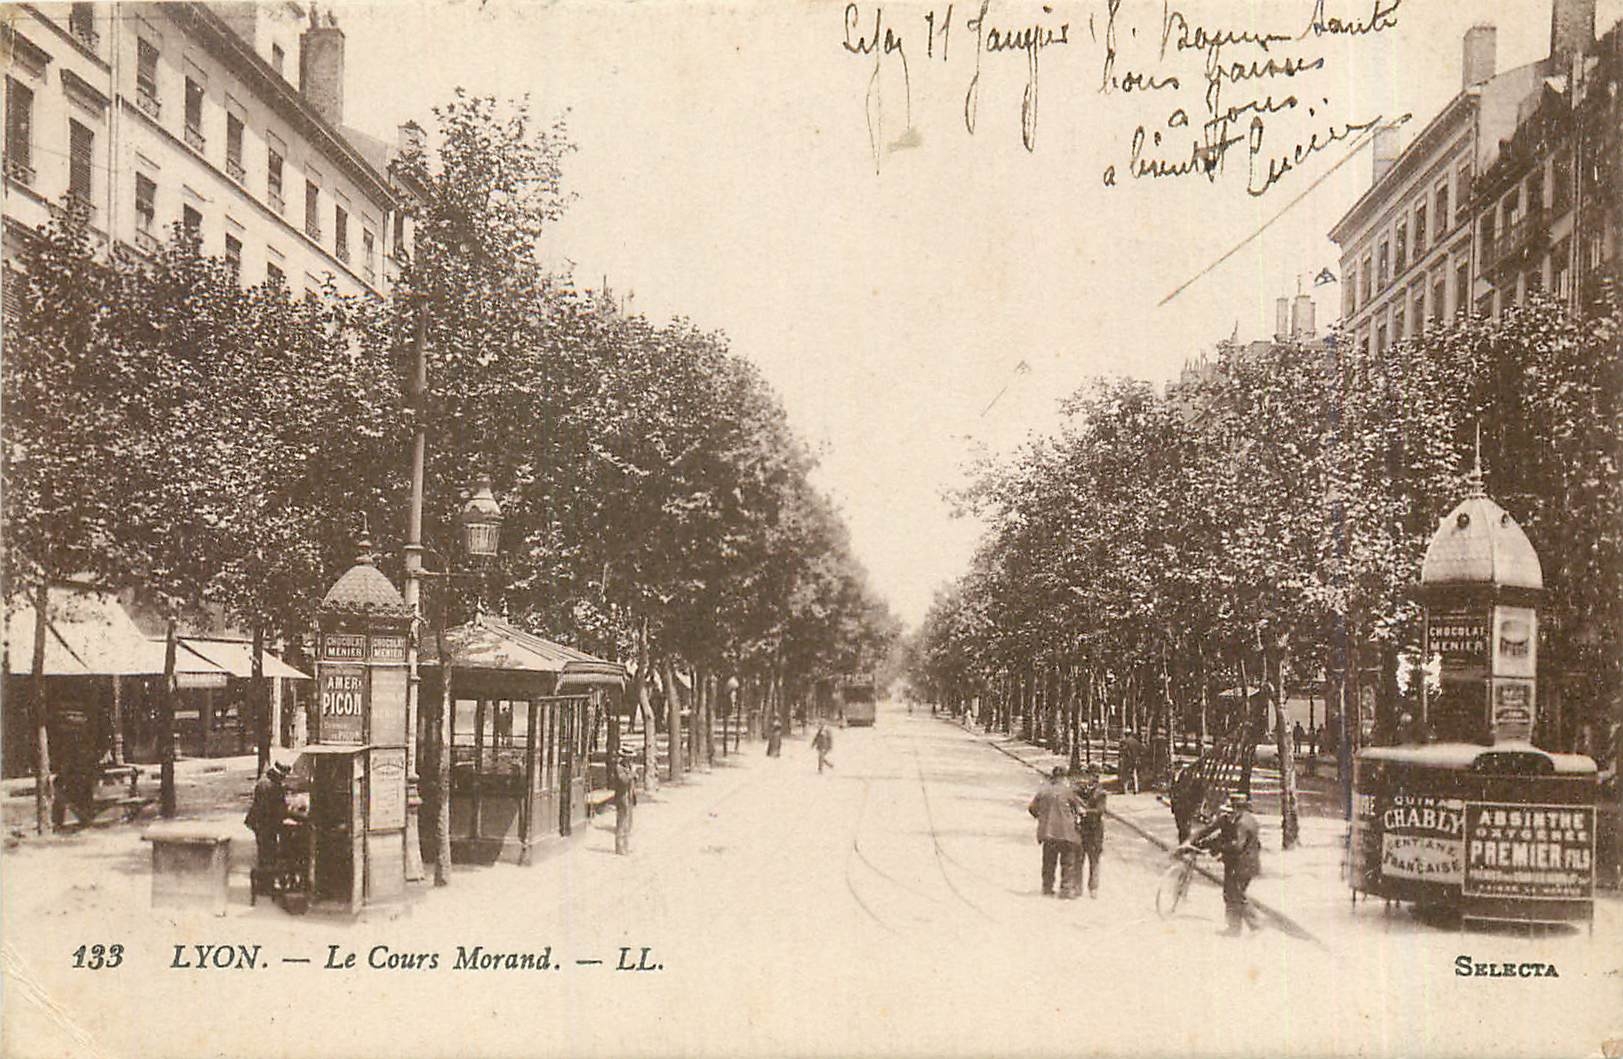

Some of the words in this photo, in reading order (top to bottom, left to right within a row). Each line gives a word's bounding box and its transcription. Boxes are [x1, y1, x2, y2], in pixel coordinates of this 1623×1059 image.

[1429, 626, 1485, 637] CHOCOLAT
[328, 647, 362, 657] MENIER
[1430, 641, 1484, 652] MENIER
[323, 692, 362, 716] PICON
[1384, 808, 1465, 834] CHABLY
[1480, 811, 1584, 829] ABSINTHE
[1471, 841, 1561, 868] PREMIER
